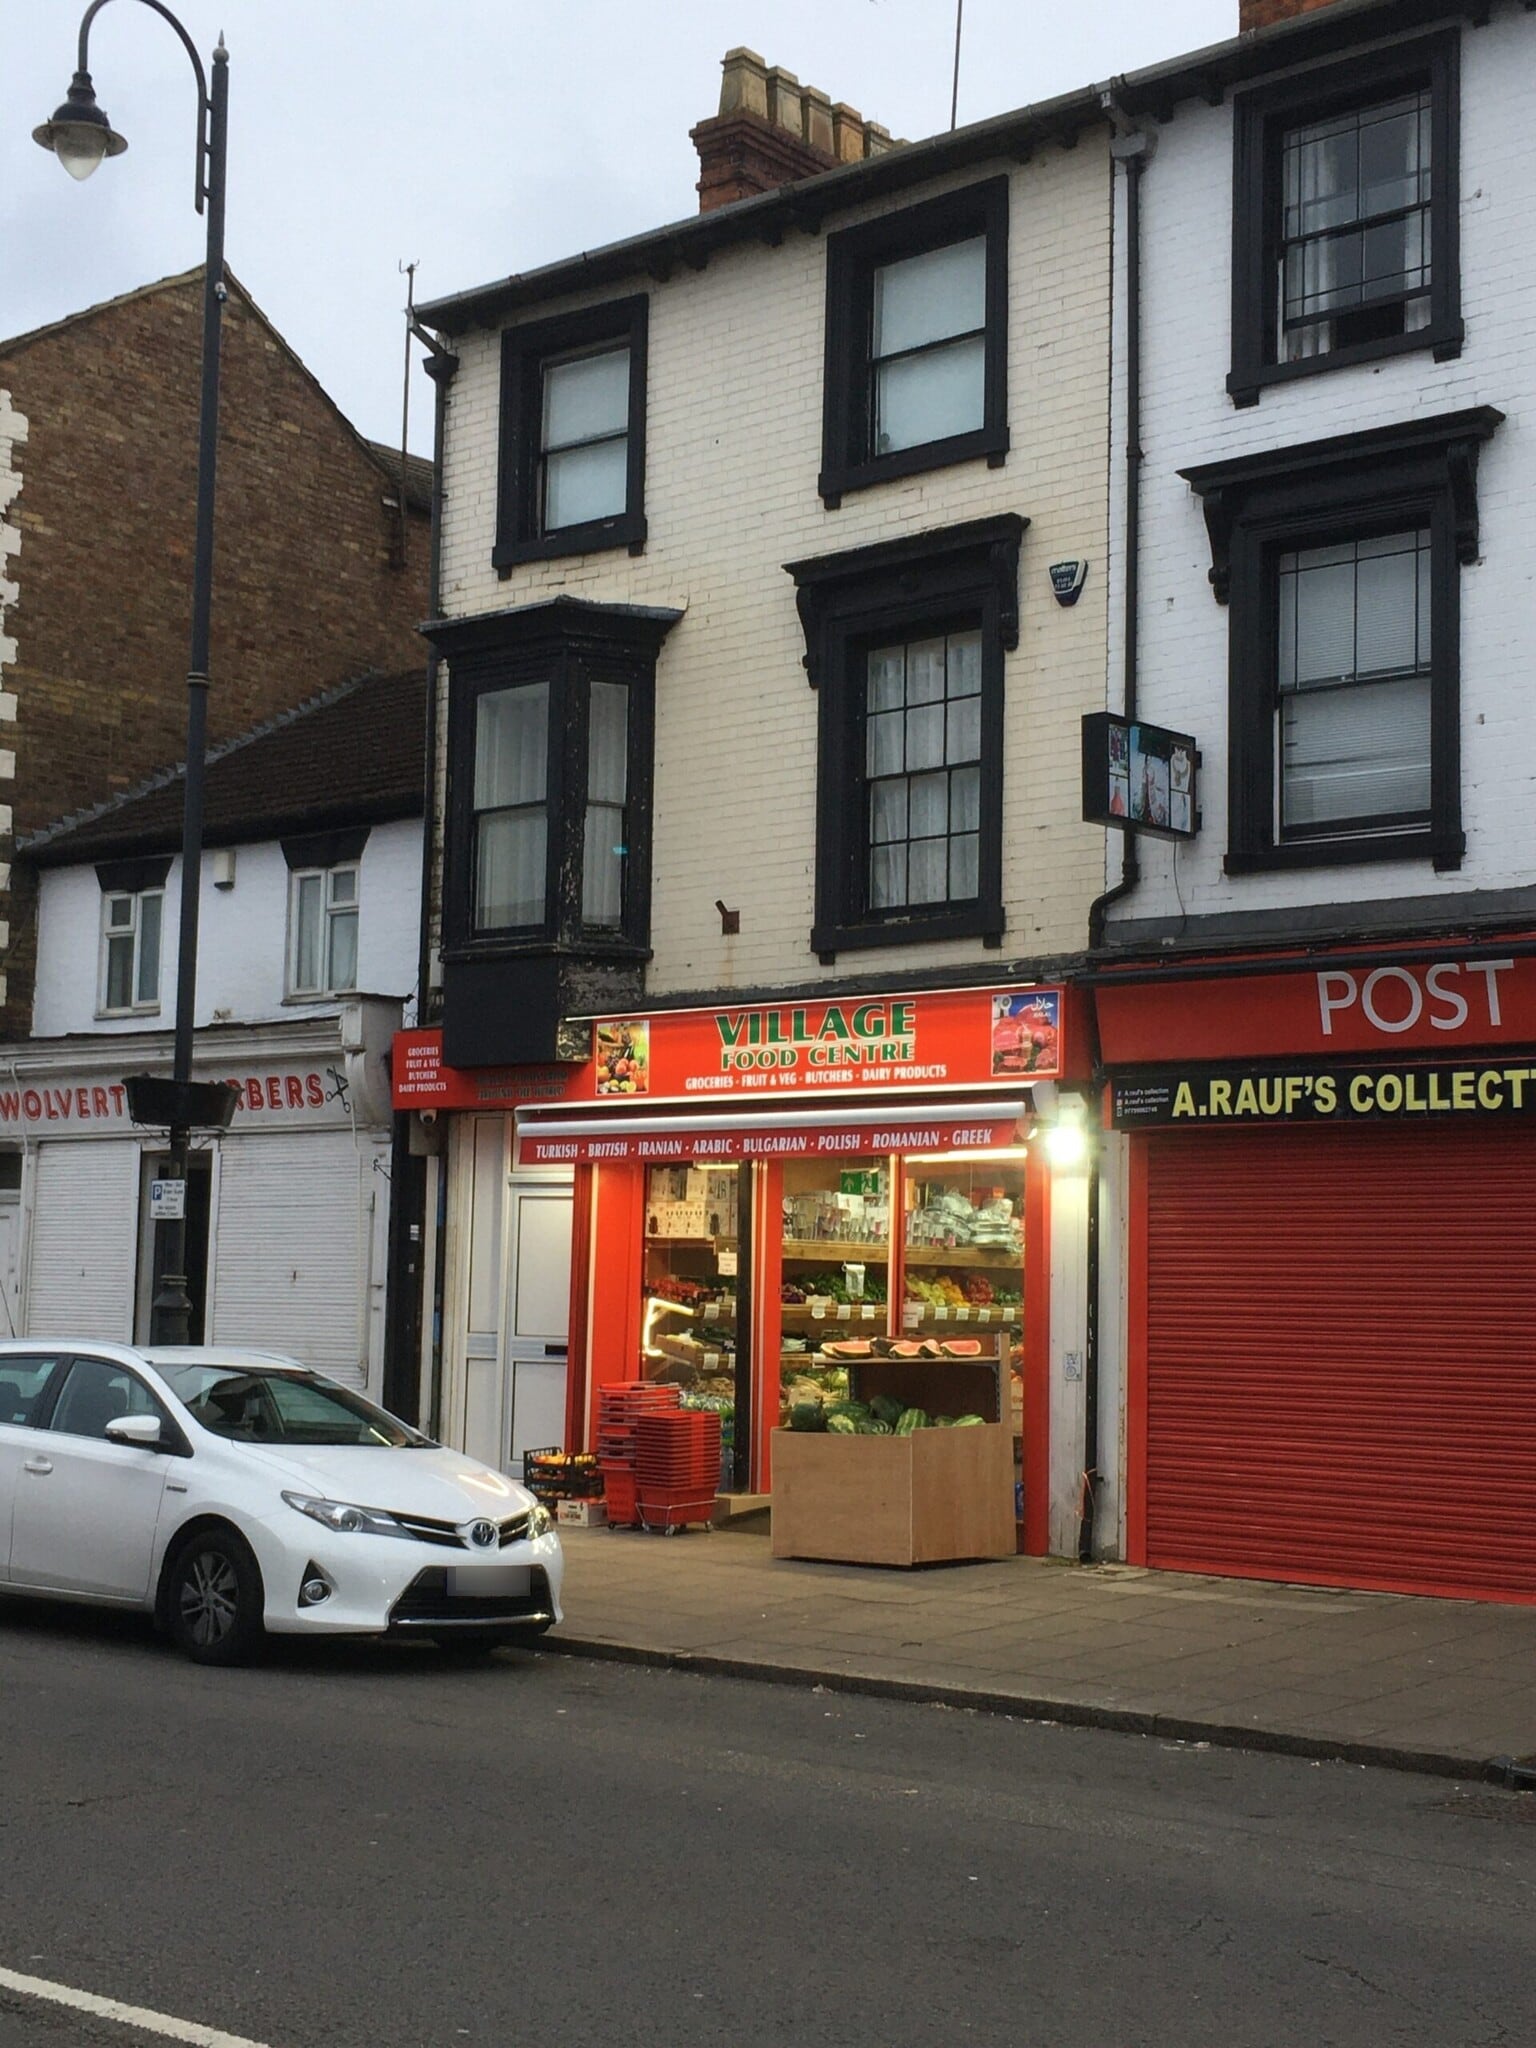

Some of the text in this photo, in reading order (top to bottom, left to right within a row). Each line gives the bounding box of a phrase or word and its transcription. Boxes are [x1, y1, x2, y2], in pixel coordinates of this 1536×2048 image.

[1316, 958, 1514, 1035] POST
[714, 1001, 916, 1047] VILLAGE
[406, 1059, 422, 1069] FRUIT
[429, 1058, 440, 1068] VEG
[408, 1046, 439, 1057] GROCERIES
[721, 1041, 916, 1071] FOOD CENTRE
[399, 1081, 446, 1093] DAIRY PRODUCTS
[409, 1070, 437, 1081] BUTCHERS
[686, 1075, 733, 1090] GROCERIES
[742, 1073, 767, 1087] FRUIT
[779, 1072, 797, 1085] VEG
[805, 1068, 853, 1084] BUTCHERS
[862, 1067, 890, 1081] DAIRY
[894, 1064, 947, 1079] PRODUCTS
[0, 1085, 125, 1121] WOLVERT
[1172, 1069, 1536, 1118] A.RAUF'S COLLECT
[536, 1128, 992, 1159] TURKISH BRITISH IRANIAN ARABIC BULGARIAN POLISH ROMANIAN GREEK
